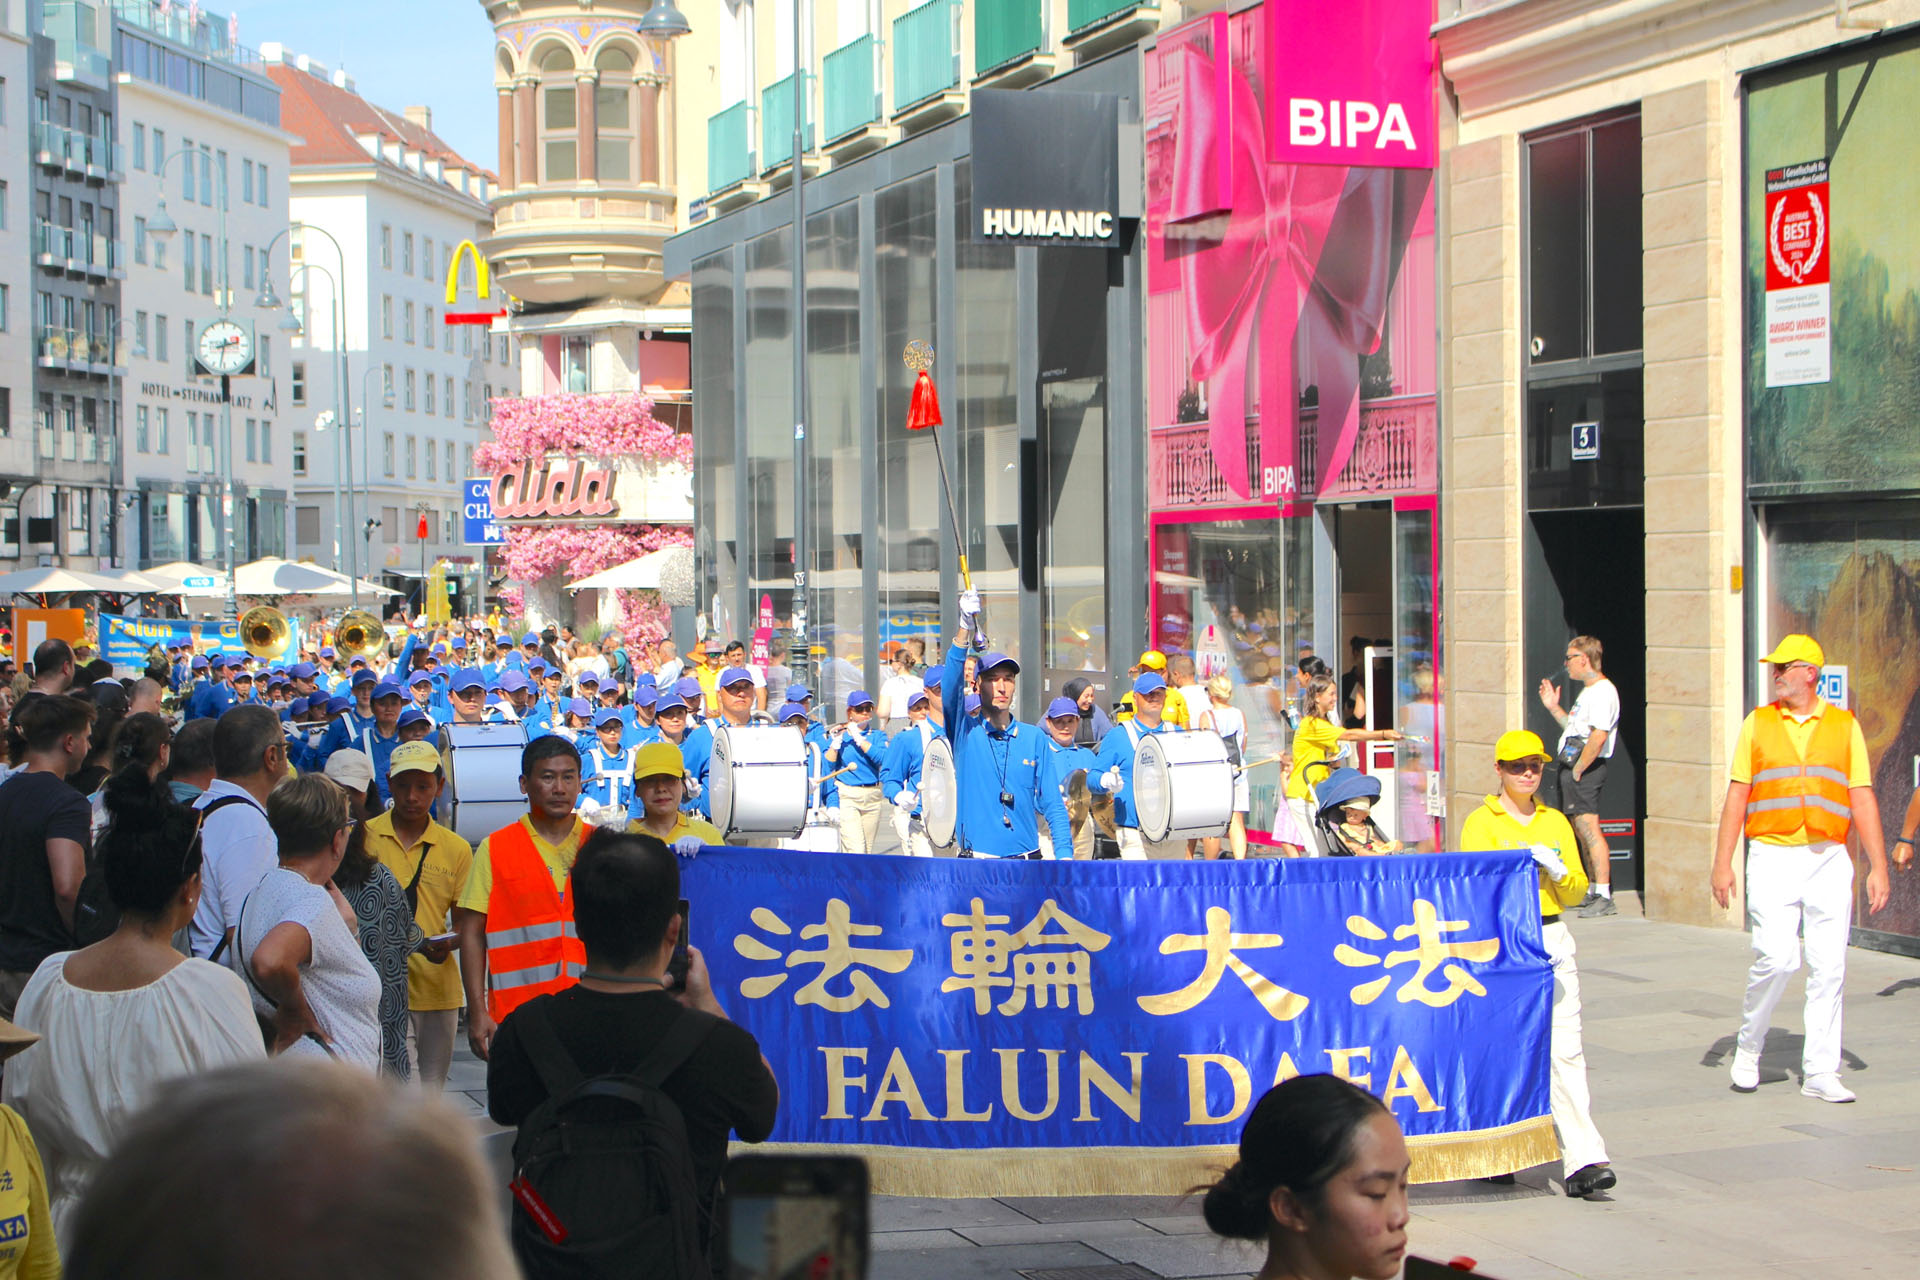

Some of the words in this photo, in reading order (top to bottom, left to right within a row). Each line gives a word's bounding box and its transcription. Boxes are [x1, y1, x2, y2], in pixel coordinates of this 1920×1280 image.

[1290, 98, 1417, 150] BIPA
[983, 208, 1113, 239] HUMANIC
[1783, 220, 1812, 242] BEST
[1797, 317, 1826, 330] WINNER
[142, 382, 170, 399] HOTEL
[1579, 427, 1588, 447] 5
[1264, 465, 1297, 495] BIPA
[110, 618, 173, 638] Falun
[761, 618, 773, 628] SAE
[733, 897, 1500, 1021] 法輪大法
[817, 1046, 1149, 1122] FALUN
